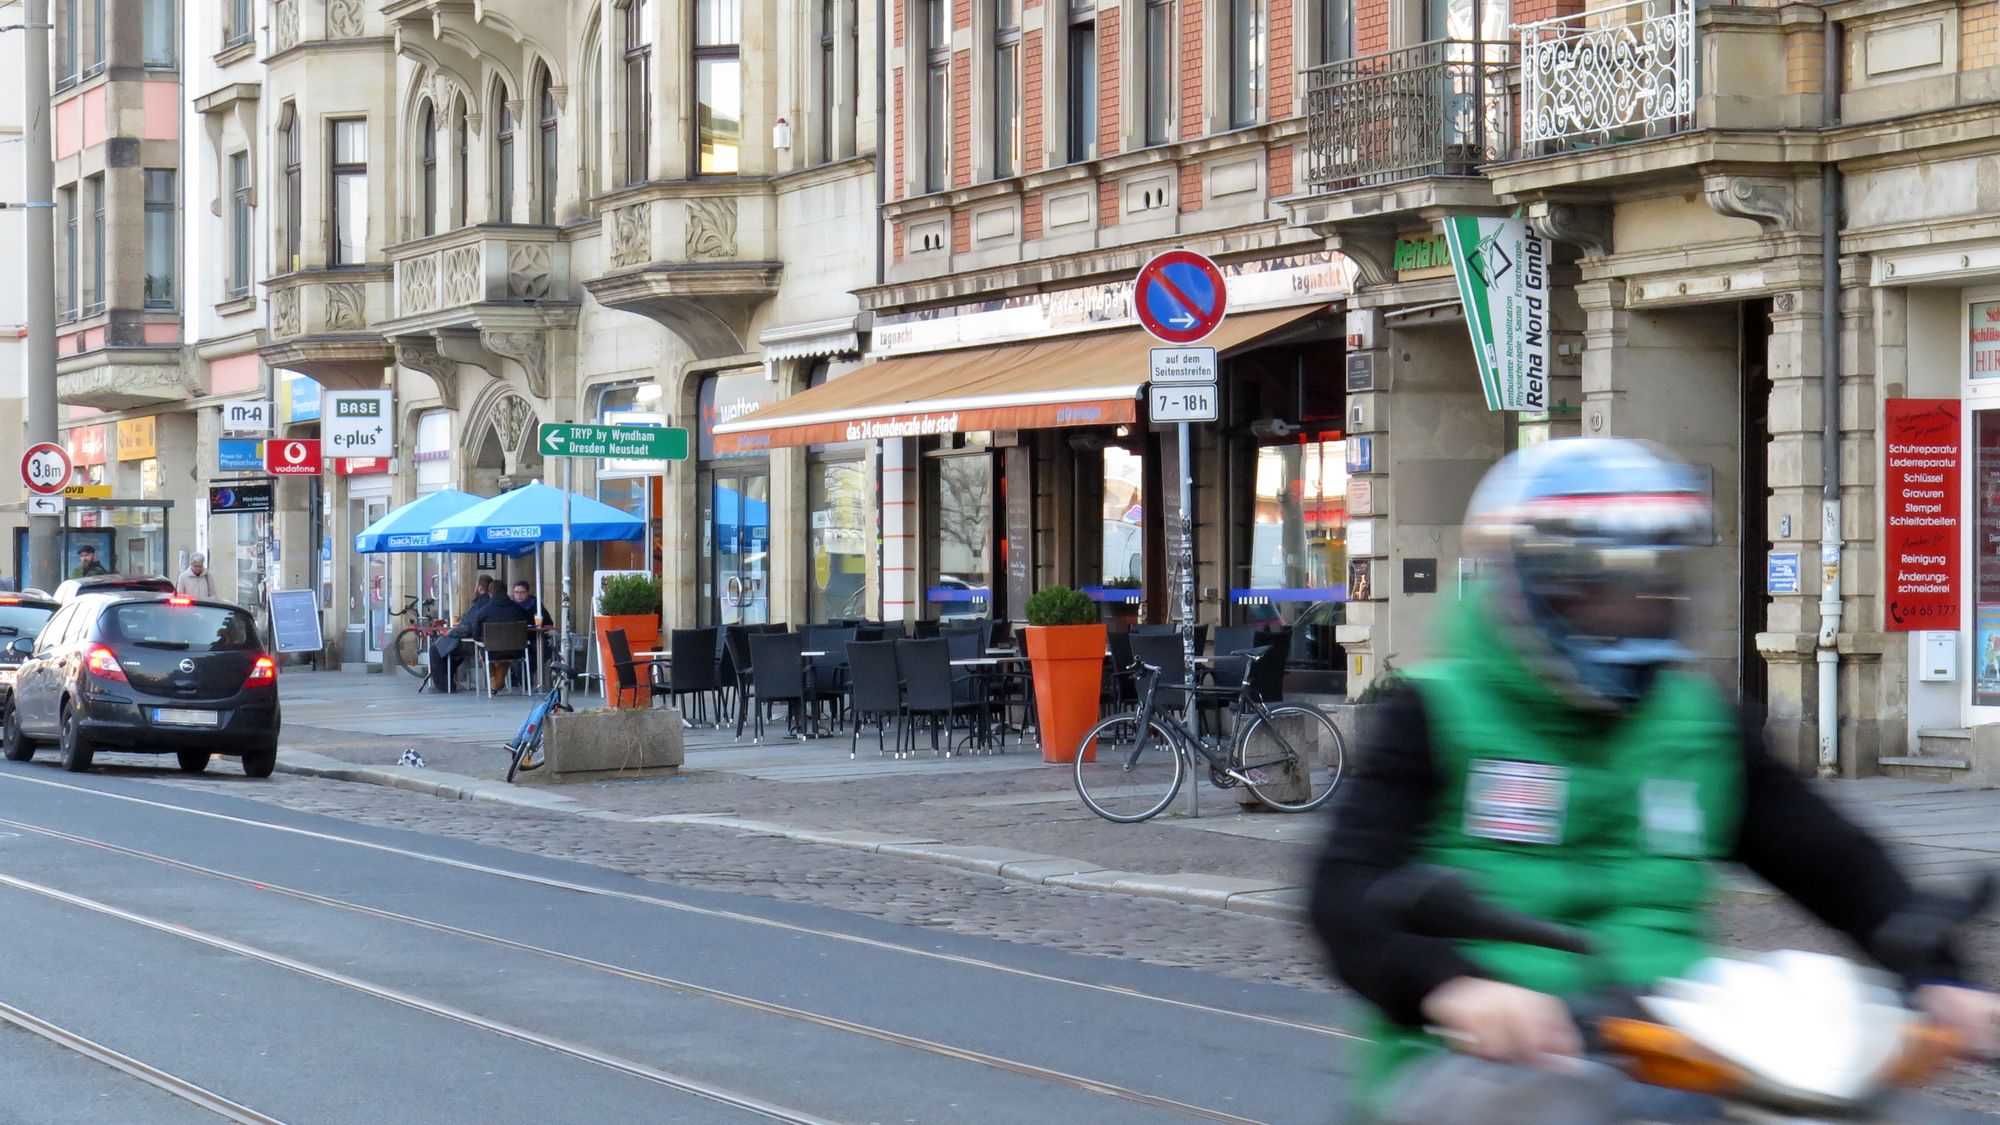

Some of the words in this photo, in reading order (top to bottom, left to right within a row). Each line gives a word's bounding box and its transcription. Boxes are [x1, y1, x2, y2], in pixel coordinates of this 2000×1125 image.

[1514, 240, 1523, 298] Ergotherapie
[1514, 305, 1523, 333] Sauna
[1525, 296, 1543, 348] Nord
[1165, 354, 1178, 364] auf
[1183, 354, 1200, 364] dem
[1155, 366, 1212, 377] Seitenstreifen
[1525, 353, 1543, 408] Reha
[340, 402, 376, 414] BASE
[1160, 395, 1167, 411] 7
[847, 421, 860, 441] das
[861, 420, 871, 439] 24
[921, 415, 936, 434] der
[570, 427, 593, 439] TRYP
[596, 429, 608, 443] by
[611, 429, 655, 443] Wyndham
[569, 441, 606, 454] Dresden
[609, 443, 649, 456] Neustadt
[1889, 444, 1957, 455] Schuhreparatur
[275, 465, 315, 473] vodafone
[1890, 458, 1956, 469] Lederreparatur
[1903, 473, 1943, 483] Schlüssel
[65, 486, 84, 494] DVB
[1902, 488, 1944, 498] Gravuren
[1905, 503, 1941, 513] Stempel
[1890, 516, 1956, 526] Schleifarbeiten
[489, 527, 540, 538] backWERK
[1901, 554, 1946, 565] Reinigung
[1898, 570, 1949, 583] Änderungs-
[1898, 584, 1950, 593] schneiderei
[1902, 605, 1916, 616] 64
[1919, 606, 1933, 616] 65
[1936, 605, 1957, 616] 777
